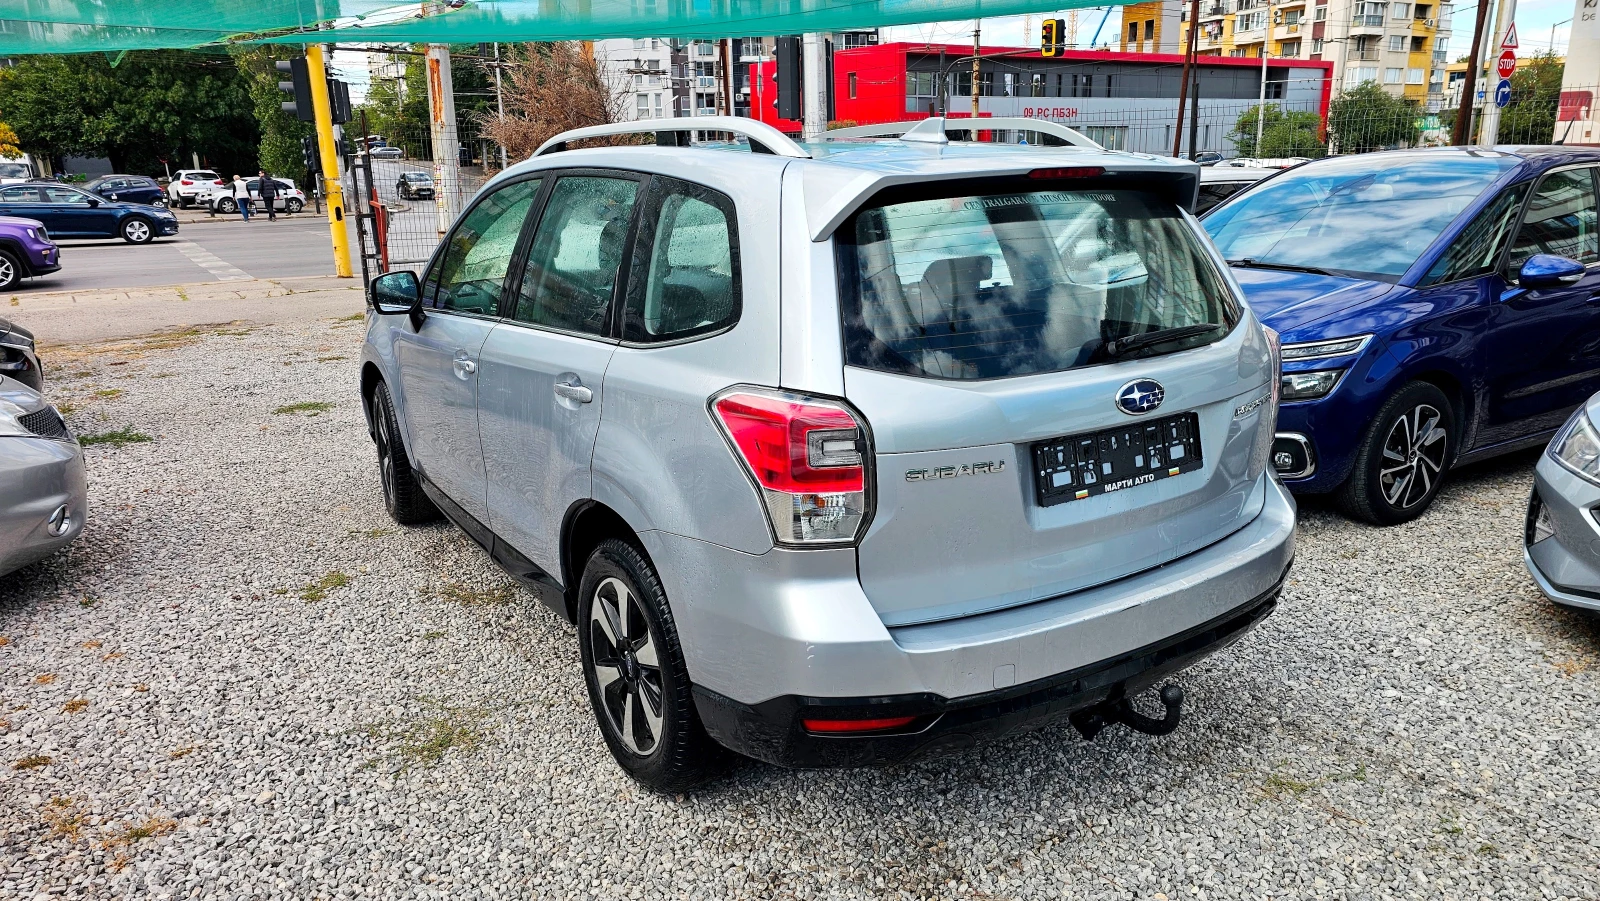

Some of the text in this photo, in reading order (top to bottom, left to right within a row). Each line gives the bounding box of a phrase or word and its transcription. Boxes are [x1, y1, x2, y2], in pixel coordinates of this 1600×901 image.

[1499, 58, 1515, 69] STOP
[1023, 107, 1078, 118] 09 РС ПБЗН
[904, 459, 1006, 482] SUBARU
[1104, 473, 1155, 492] МАРТИ АУТО
